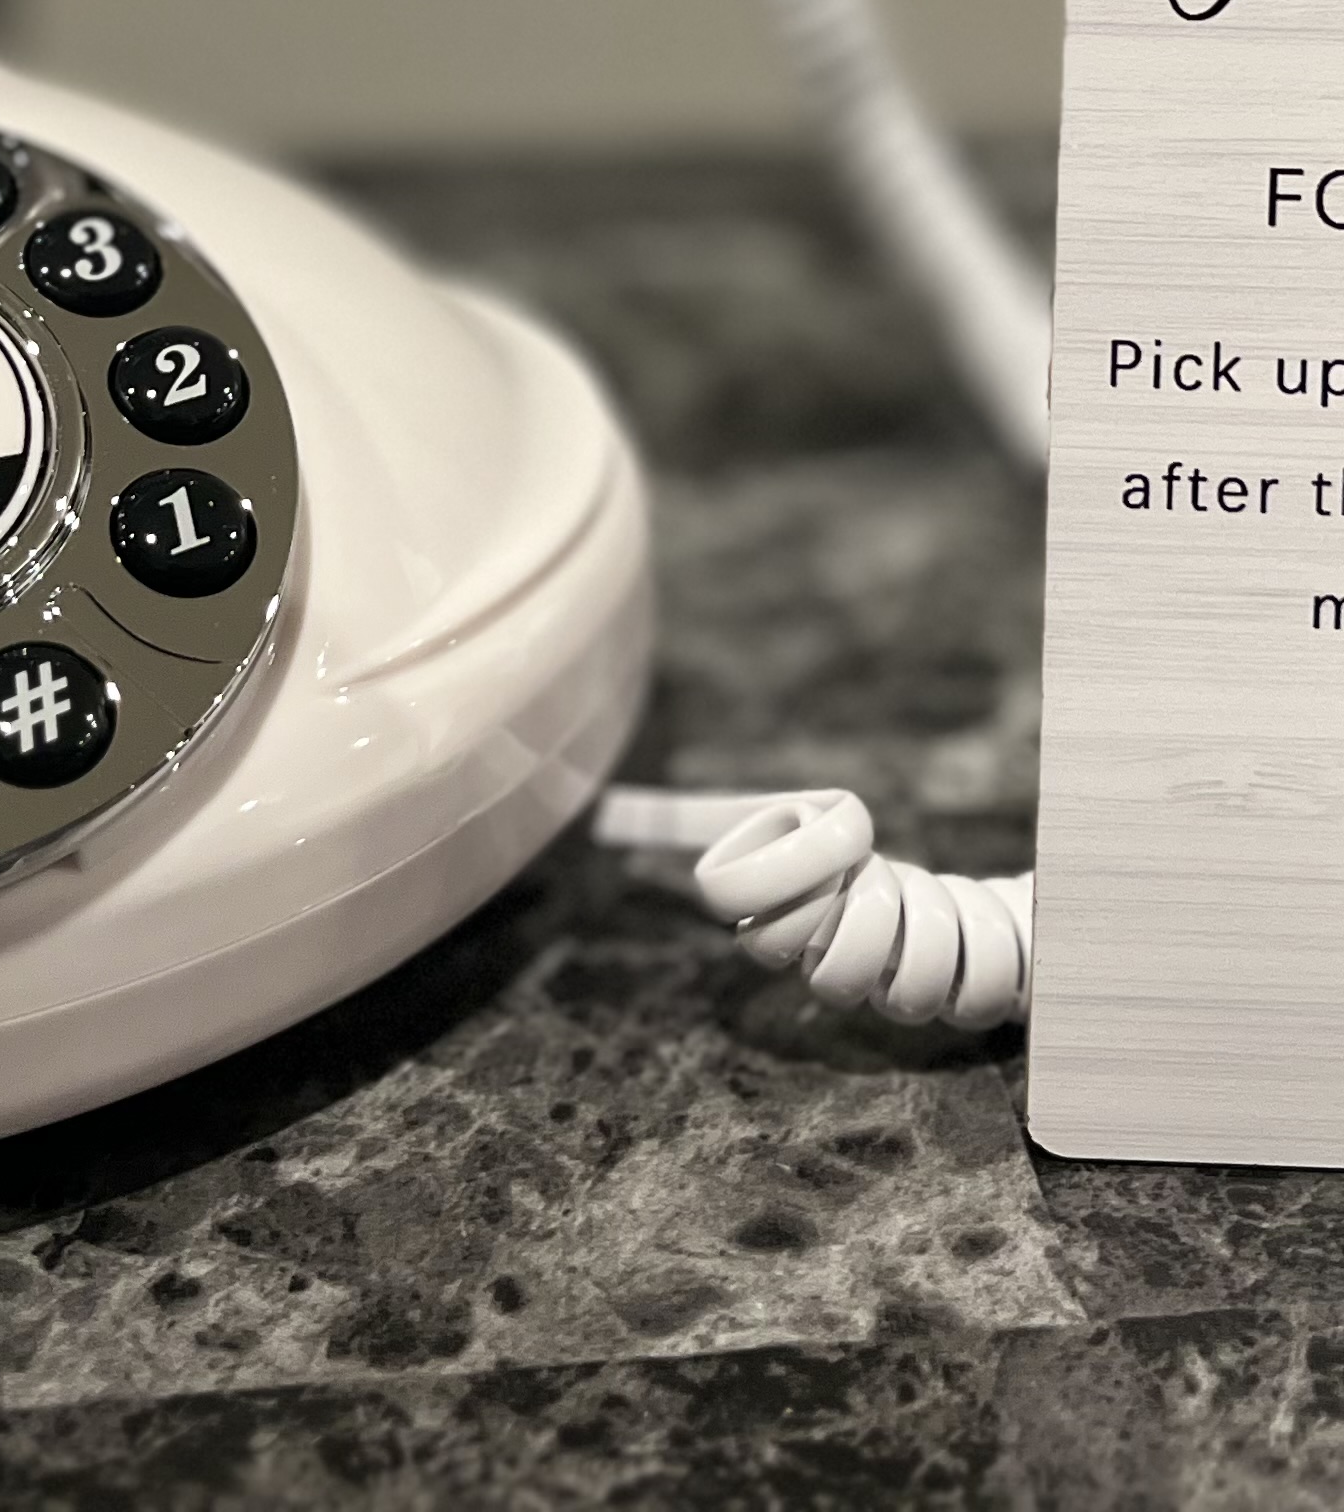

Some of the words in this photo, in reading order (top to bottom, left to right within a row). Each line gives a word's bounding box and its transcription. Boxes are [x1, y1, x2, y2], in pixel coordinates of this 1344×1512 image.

[69, 218, 123, 282] 3
[154, 343, 208, 407] 2
[1109, 338, 1242, 393] Pick
[1121, 460, 1280, 515] after
[166, 485, 211, 556] 1
